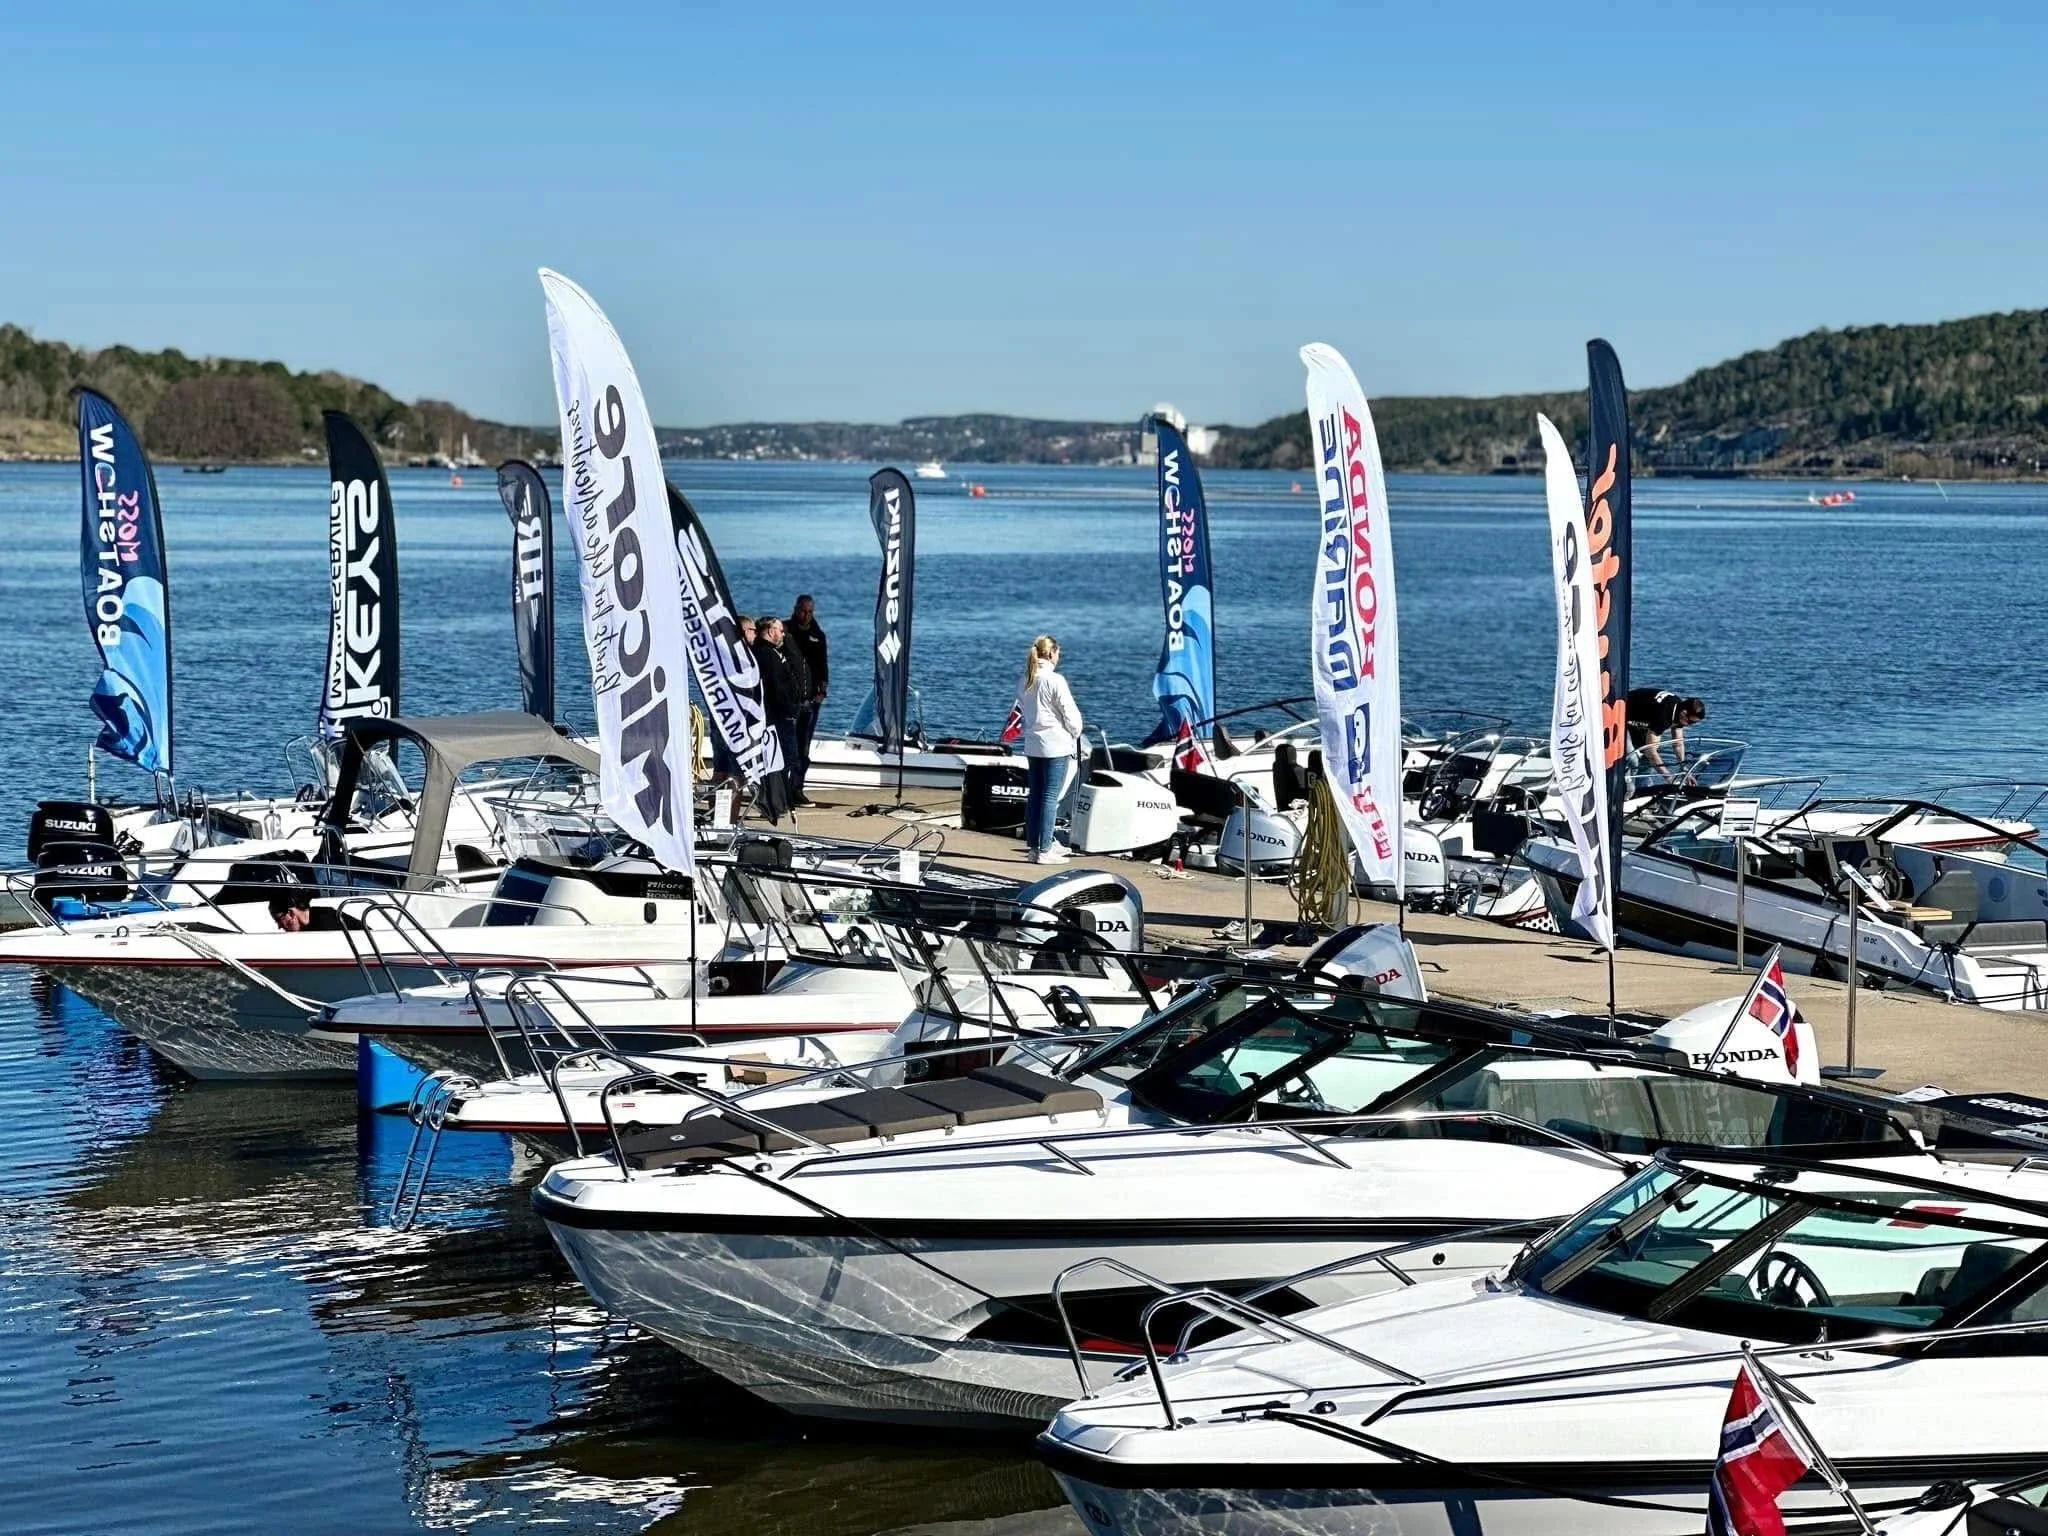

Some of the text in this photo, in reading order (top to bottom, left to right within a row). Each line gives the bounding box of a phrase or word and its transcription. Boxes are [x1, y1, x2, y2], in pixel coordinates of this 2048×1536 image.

[991, 785, 1030, 796] SUZU
[1136, 800, 1172, 810] HONDA
[44, 819, 97, 832] SUZUKI
[1404, 851, 1440, 863] NDA
[56, 864, 112, 876] SUZUKI
[1692, 1048, 1780, 1064] HONDA
